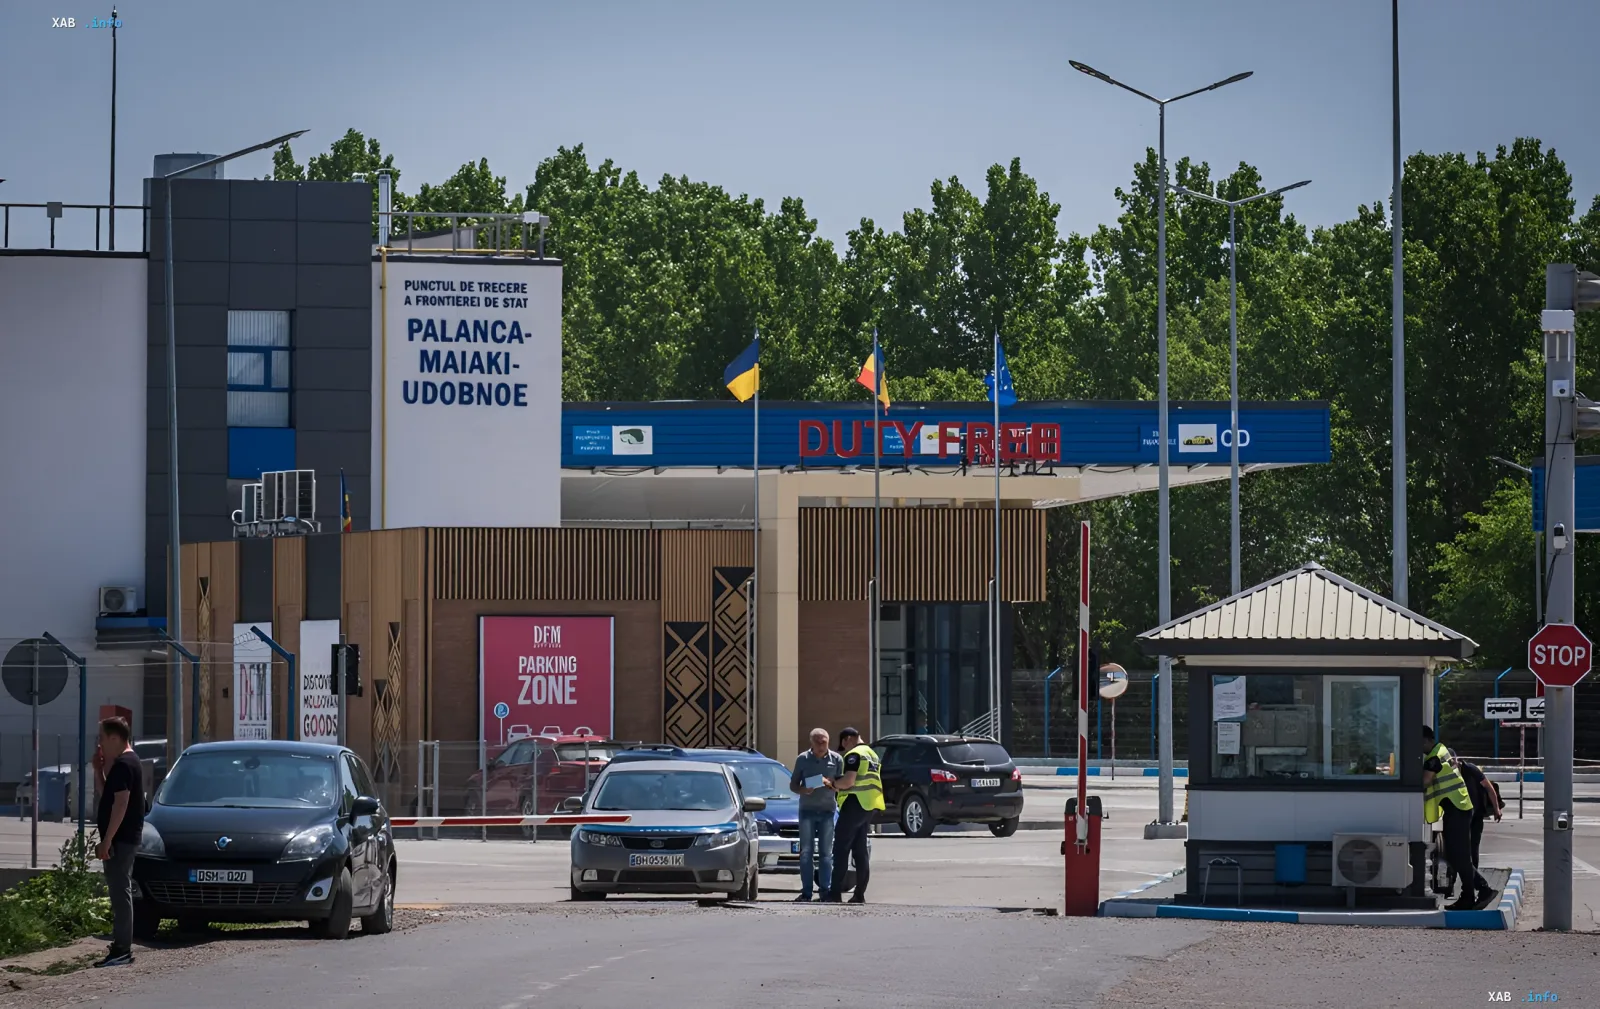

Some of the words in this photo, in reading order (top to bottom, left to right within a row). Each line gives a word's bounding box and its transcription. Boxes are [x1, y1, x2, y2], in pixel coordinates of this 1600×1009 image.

[404, 280, 456, 292] PUNCTUL
[460, 281, 475, 292] DE
[478, 282, 528, 294] TRECERE
[404, 295, 412, 306] A
[415, 295, 481, 307] FRONTIEREI
[484, 297, 499, 308] DE
[502, 298, 529, 309] STAT
[407, 318, 532, 344] PALANCA-
[419, 349, 520, 375] MAIAKI-
[402, 380, 528, 407] UDOBNOE
[799, 420, 924, 458] DUTY
[938, 421, 1061, 461] FREE
[533, 625, 561, 644] DFM
[518, 656, 577, 674] PARKING
[1534, 644, 1586, 667] STOP
[303, 674, 332, 690] DISCOV
[517, 675, 578, 705] ZONE
[303, 714, 338, 737] GOODS
